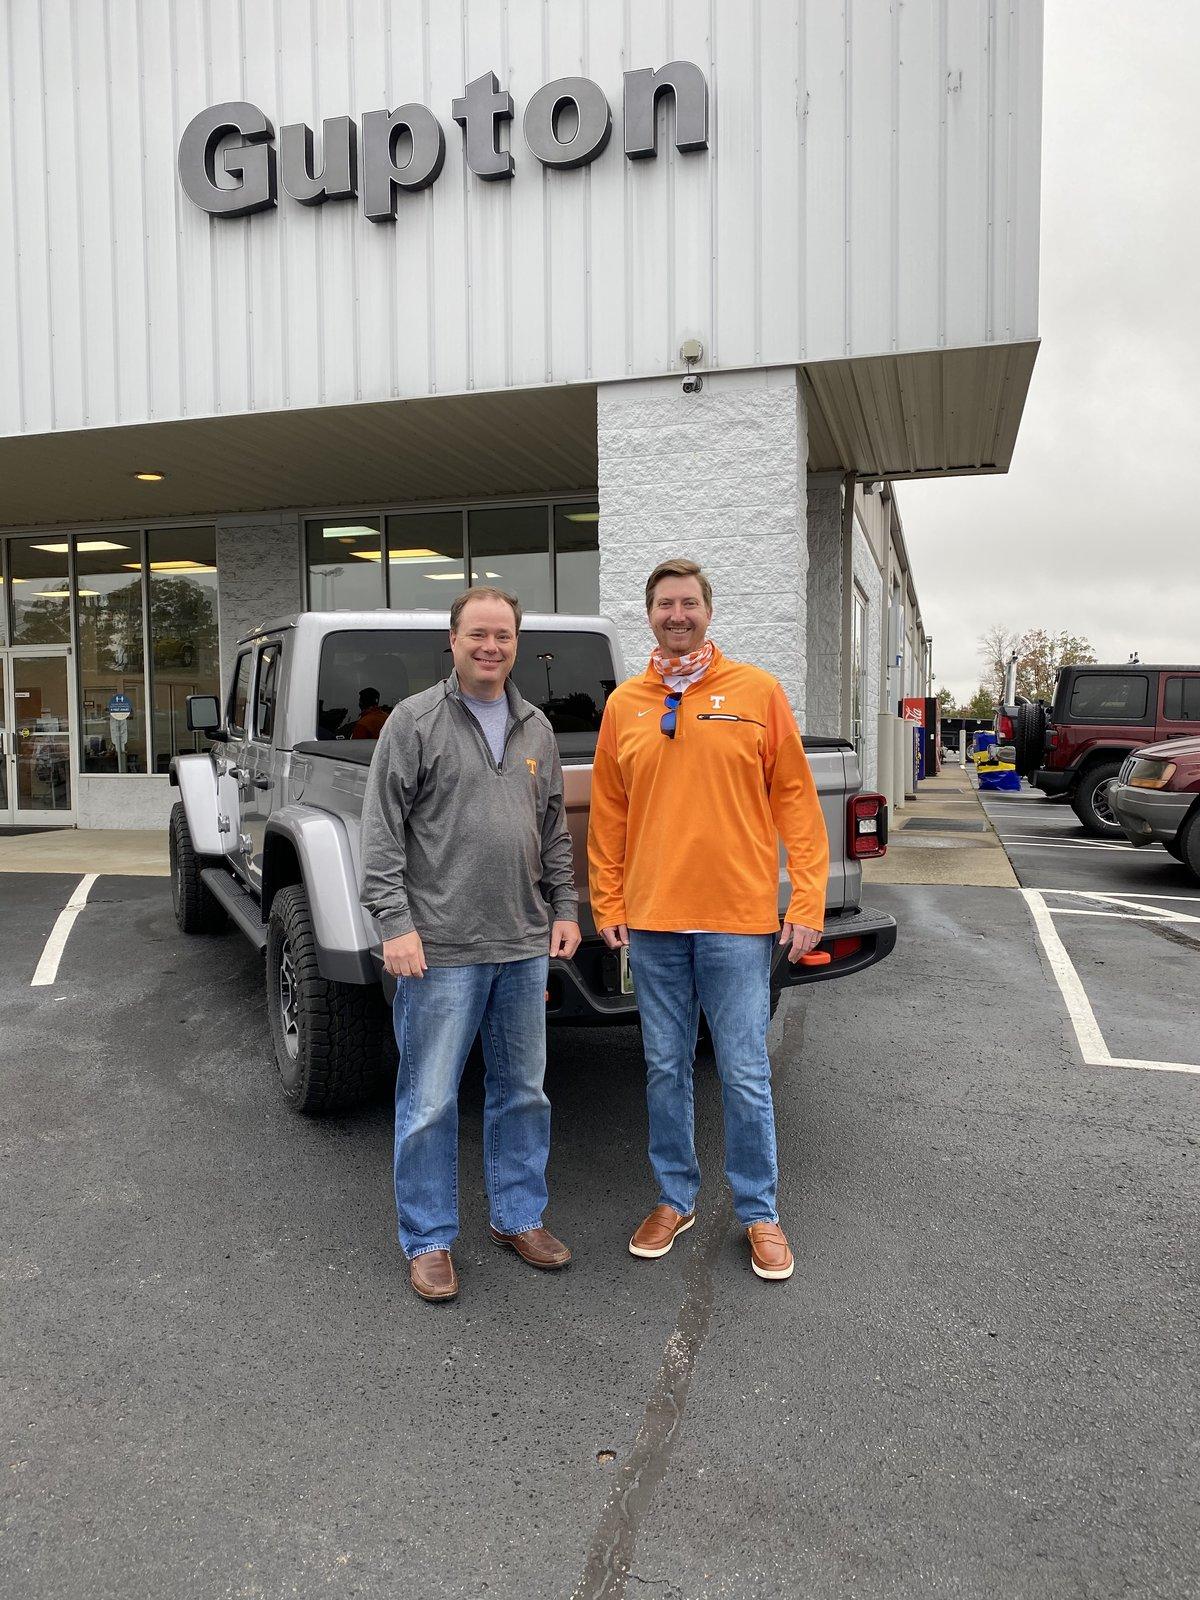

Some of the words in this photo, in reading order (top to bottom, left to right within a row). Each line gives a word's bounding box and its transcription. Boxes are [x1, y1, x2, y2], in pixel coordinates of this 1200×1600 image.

[178, 60, 709, 222] Gupton
[710, 695, 726, 710] T
[525, 758, 537, 775] T
